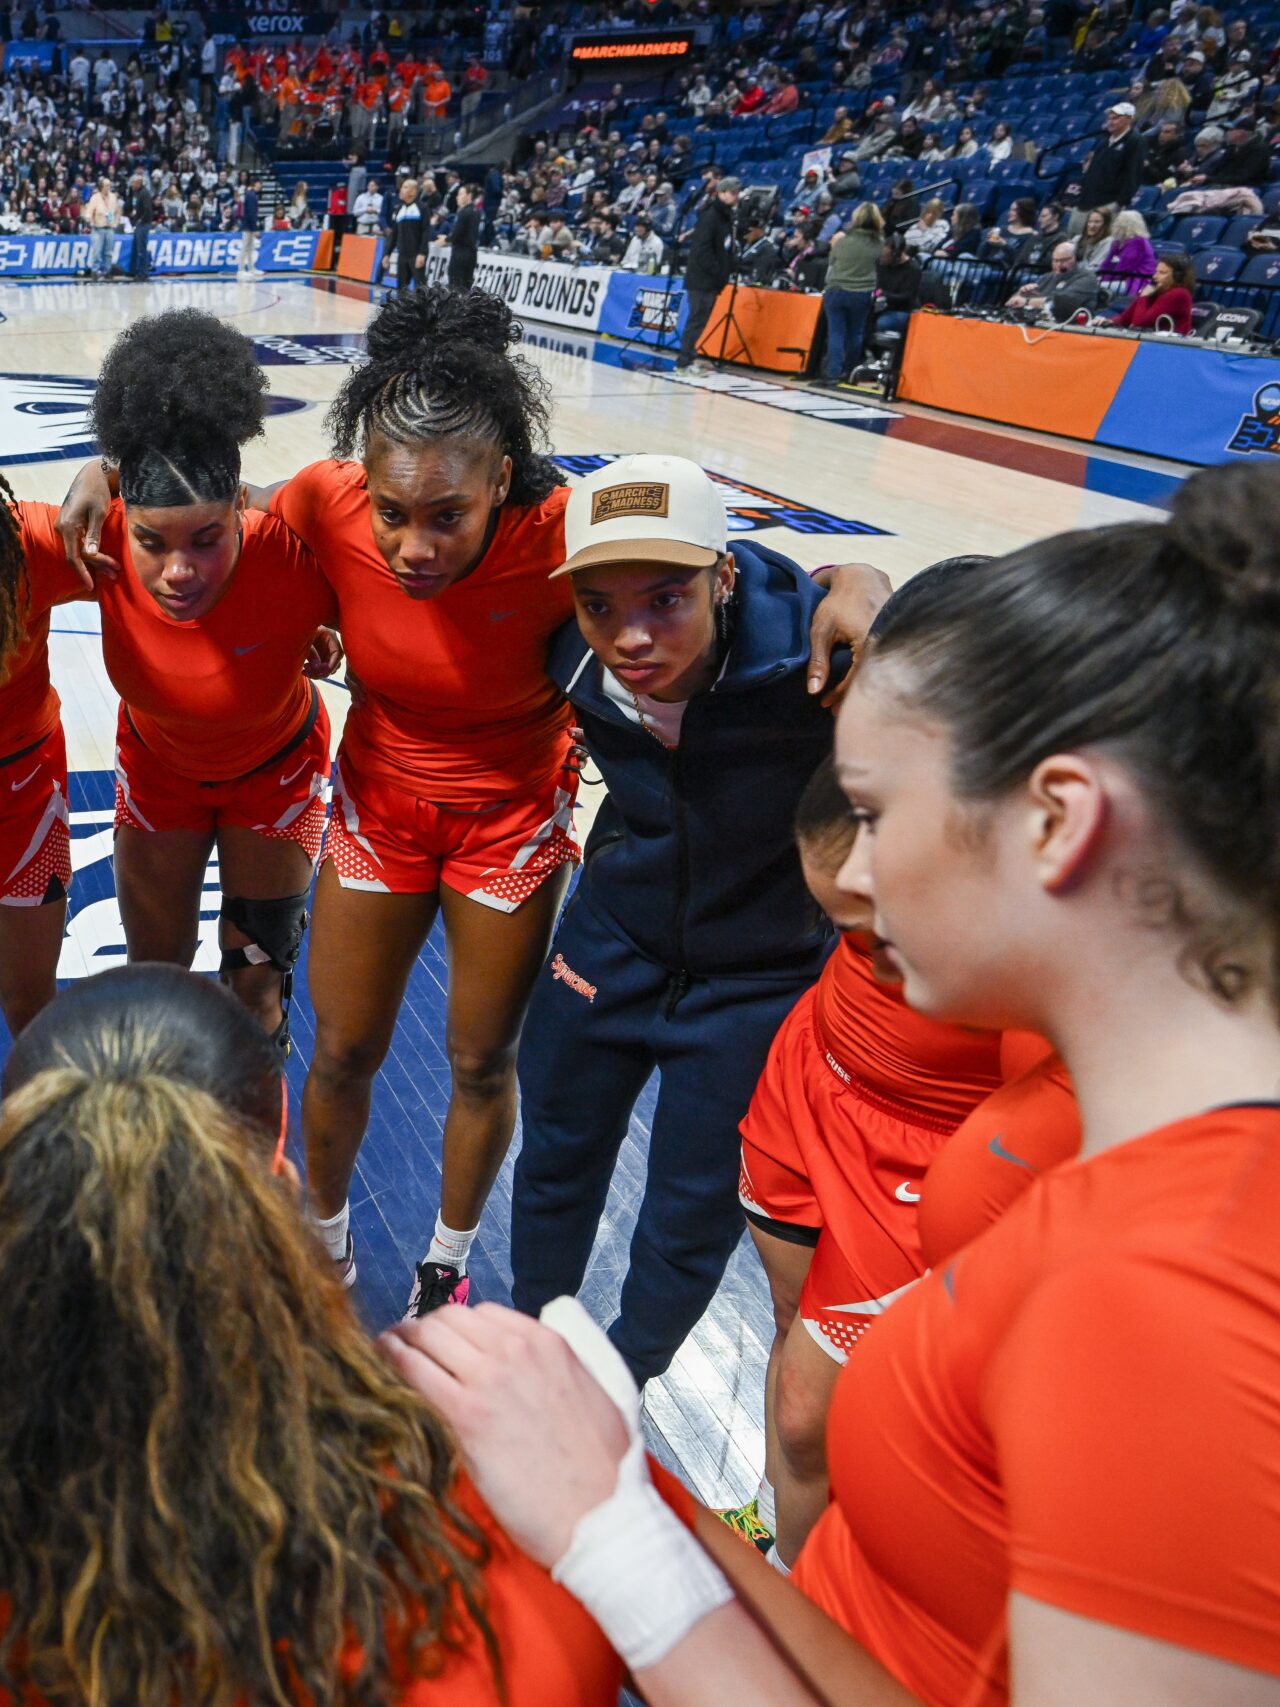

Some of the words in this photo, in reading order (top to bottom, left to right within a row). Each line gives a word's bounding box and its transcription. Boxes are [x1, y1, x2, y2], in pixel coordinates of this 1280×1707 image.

[248, 15, 304, 33] xerox
[572, 41, 689, 59] #MARCHMADNESS
[522, 271, 600, 317] ROUNDS
[1216, 312, 1250, 324] UCONN
[609, 487, 646, 500] MARCH
[610, 496, 660, 508] MADNESS
[551, 953, 598, 1001] Syracuse
[826, 1051, 852, 1085] CUSE
